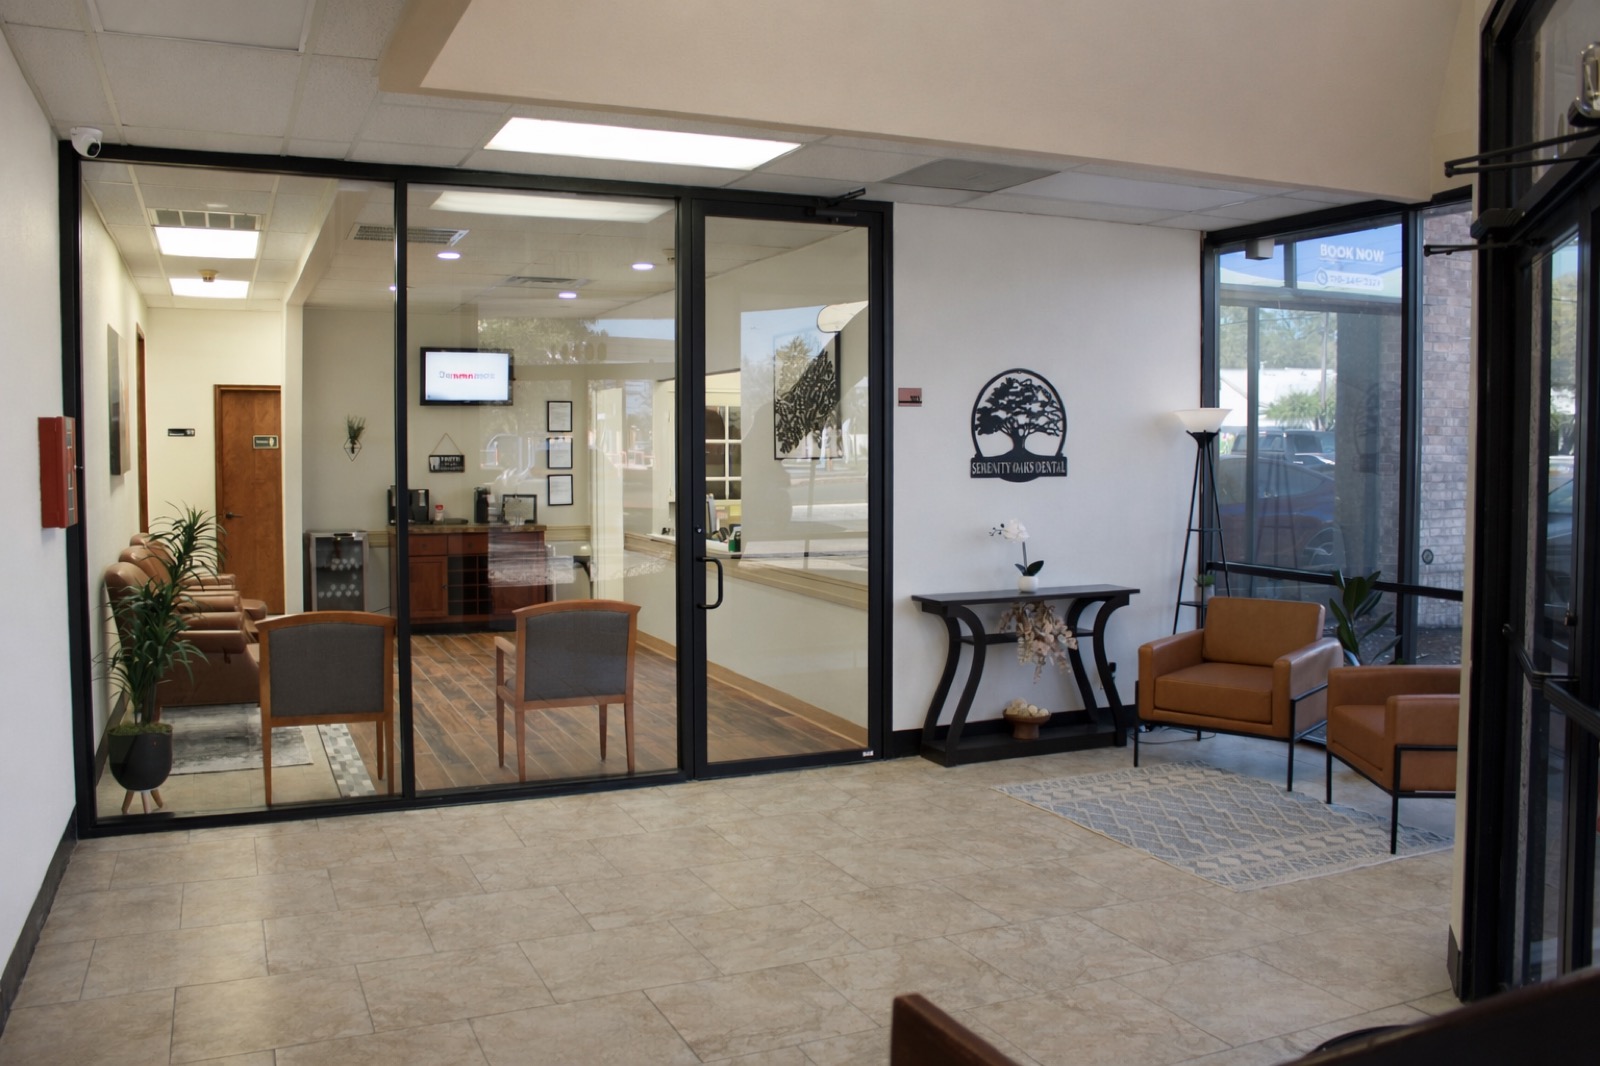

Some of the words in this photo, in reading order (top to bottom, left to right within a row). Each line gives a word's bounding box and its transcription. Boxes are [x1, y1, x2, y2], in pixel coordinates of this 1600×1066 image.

[1320, 244, 1354, 260] BOOK
[1355, 248, 1384, 262] NOW
[972, 462, 1011, 474] SERENITY
[1012, 461, 1034, 473] OAKS
[1035, 461, 1065, 473] DENTAL
